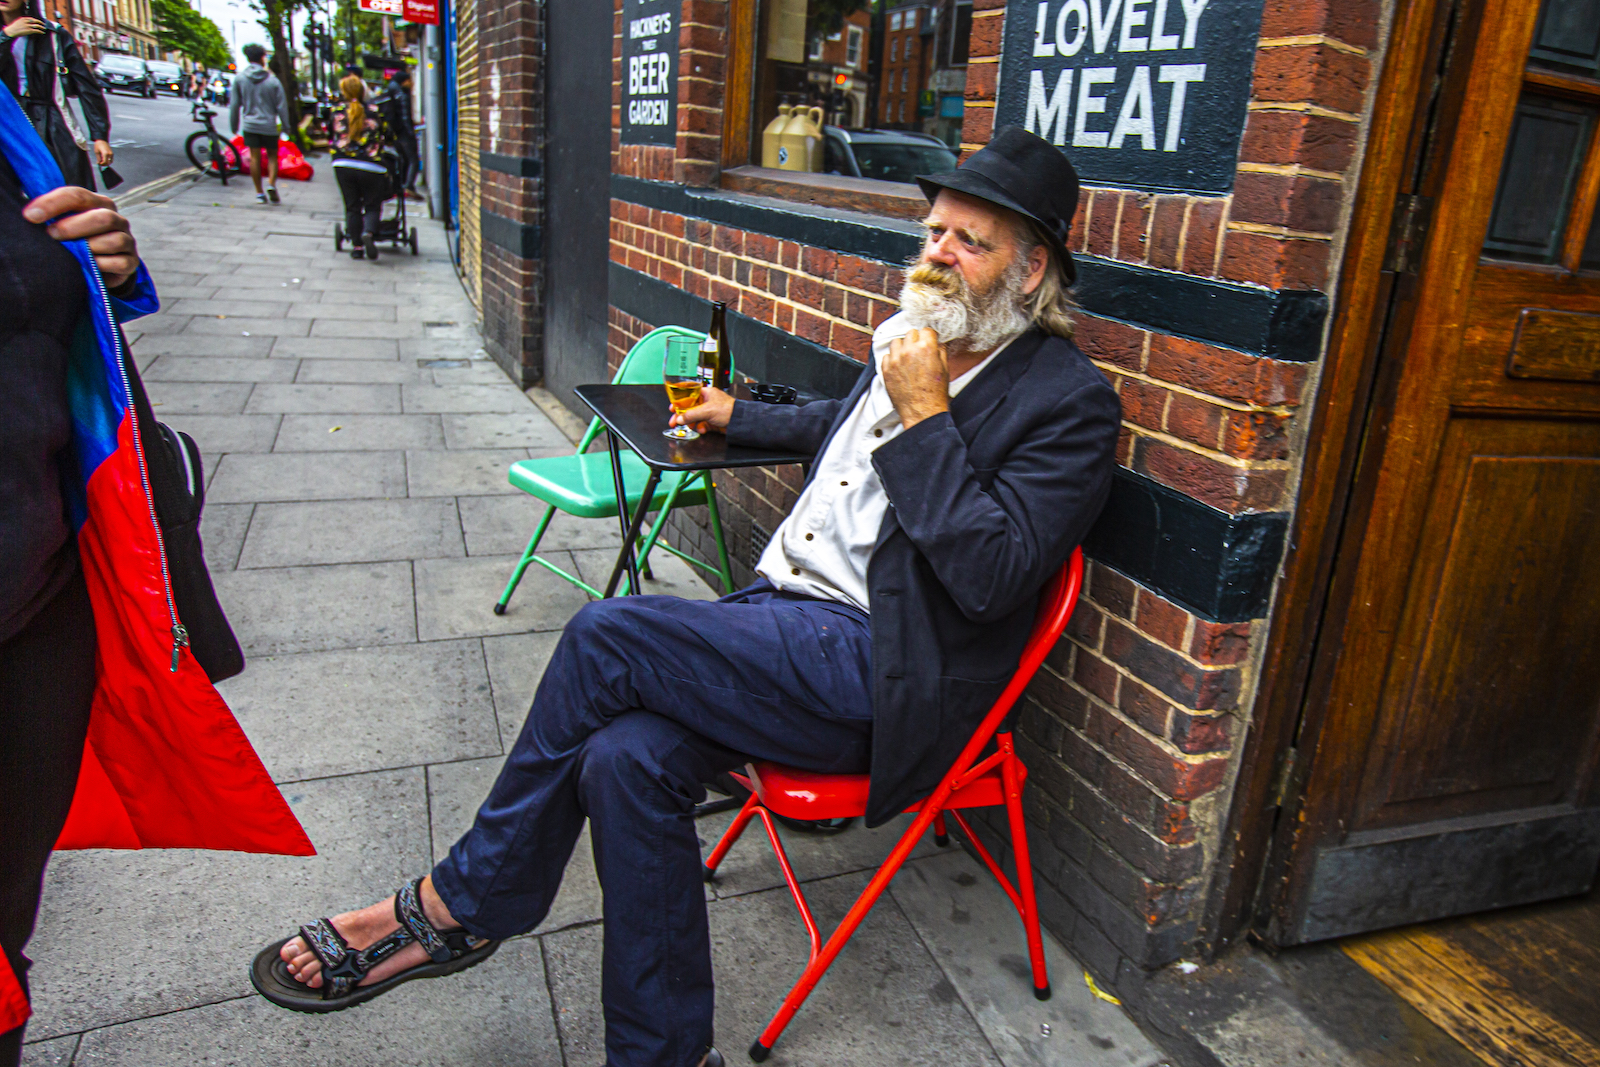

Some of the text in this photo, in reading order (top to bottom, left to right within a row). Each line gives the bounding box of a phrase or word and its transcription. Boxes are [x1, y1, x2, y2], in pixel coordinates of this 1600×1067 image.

[1033, 0, 1210, 57] LOVELY
[628, 52, 670, 95] BEER
[628, 99, 669, 125] GARDEN
[1024, 64, 1207, 152] MEAT
